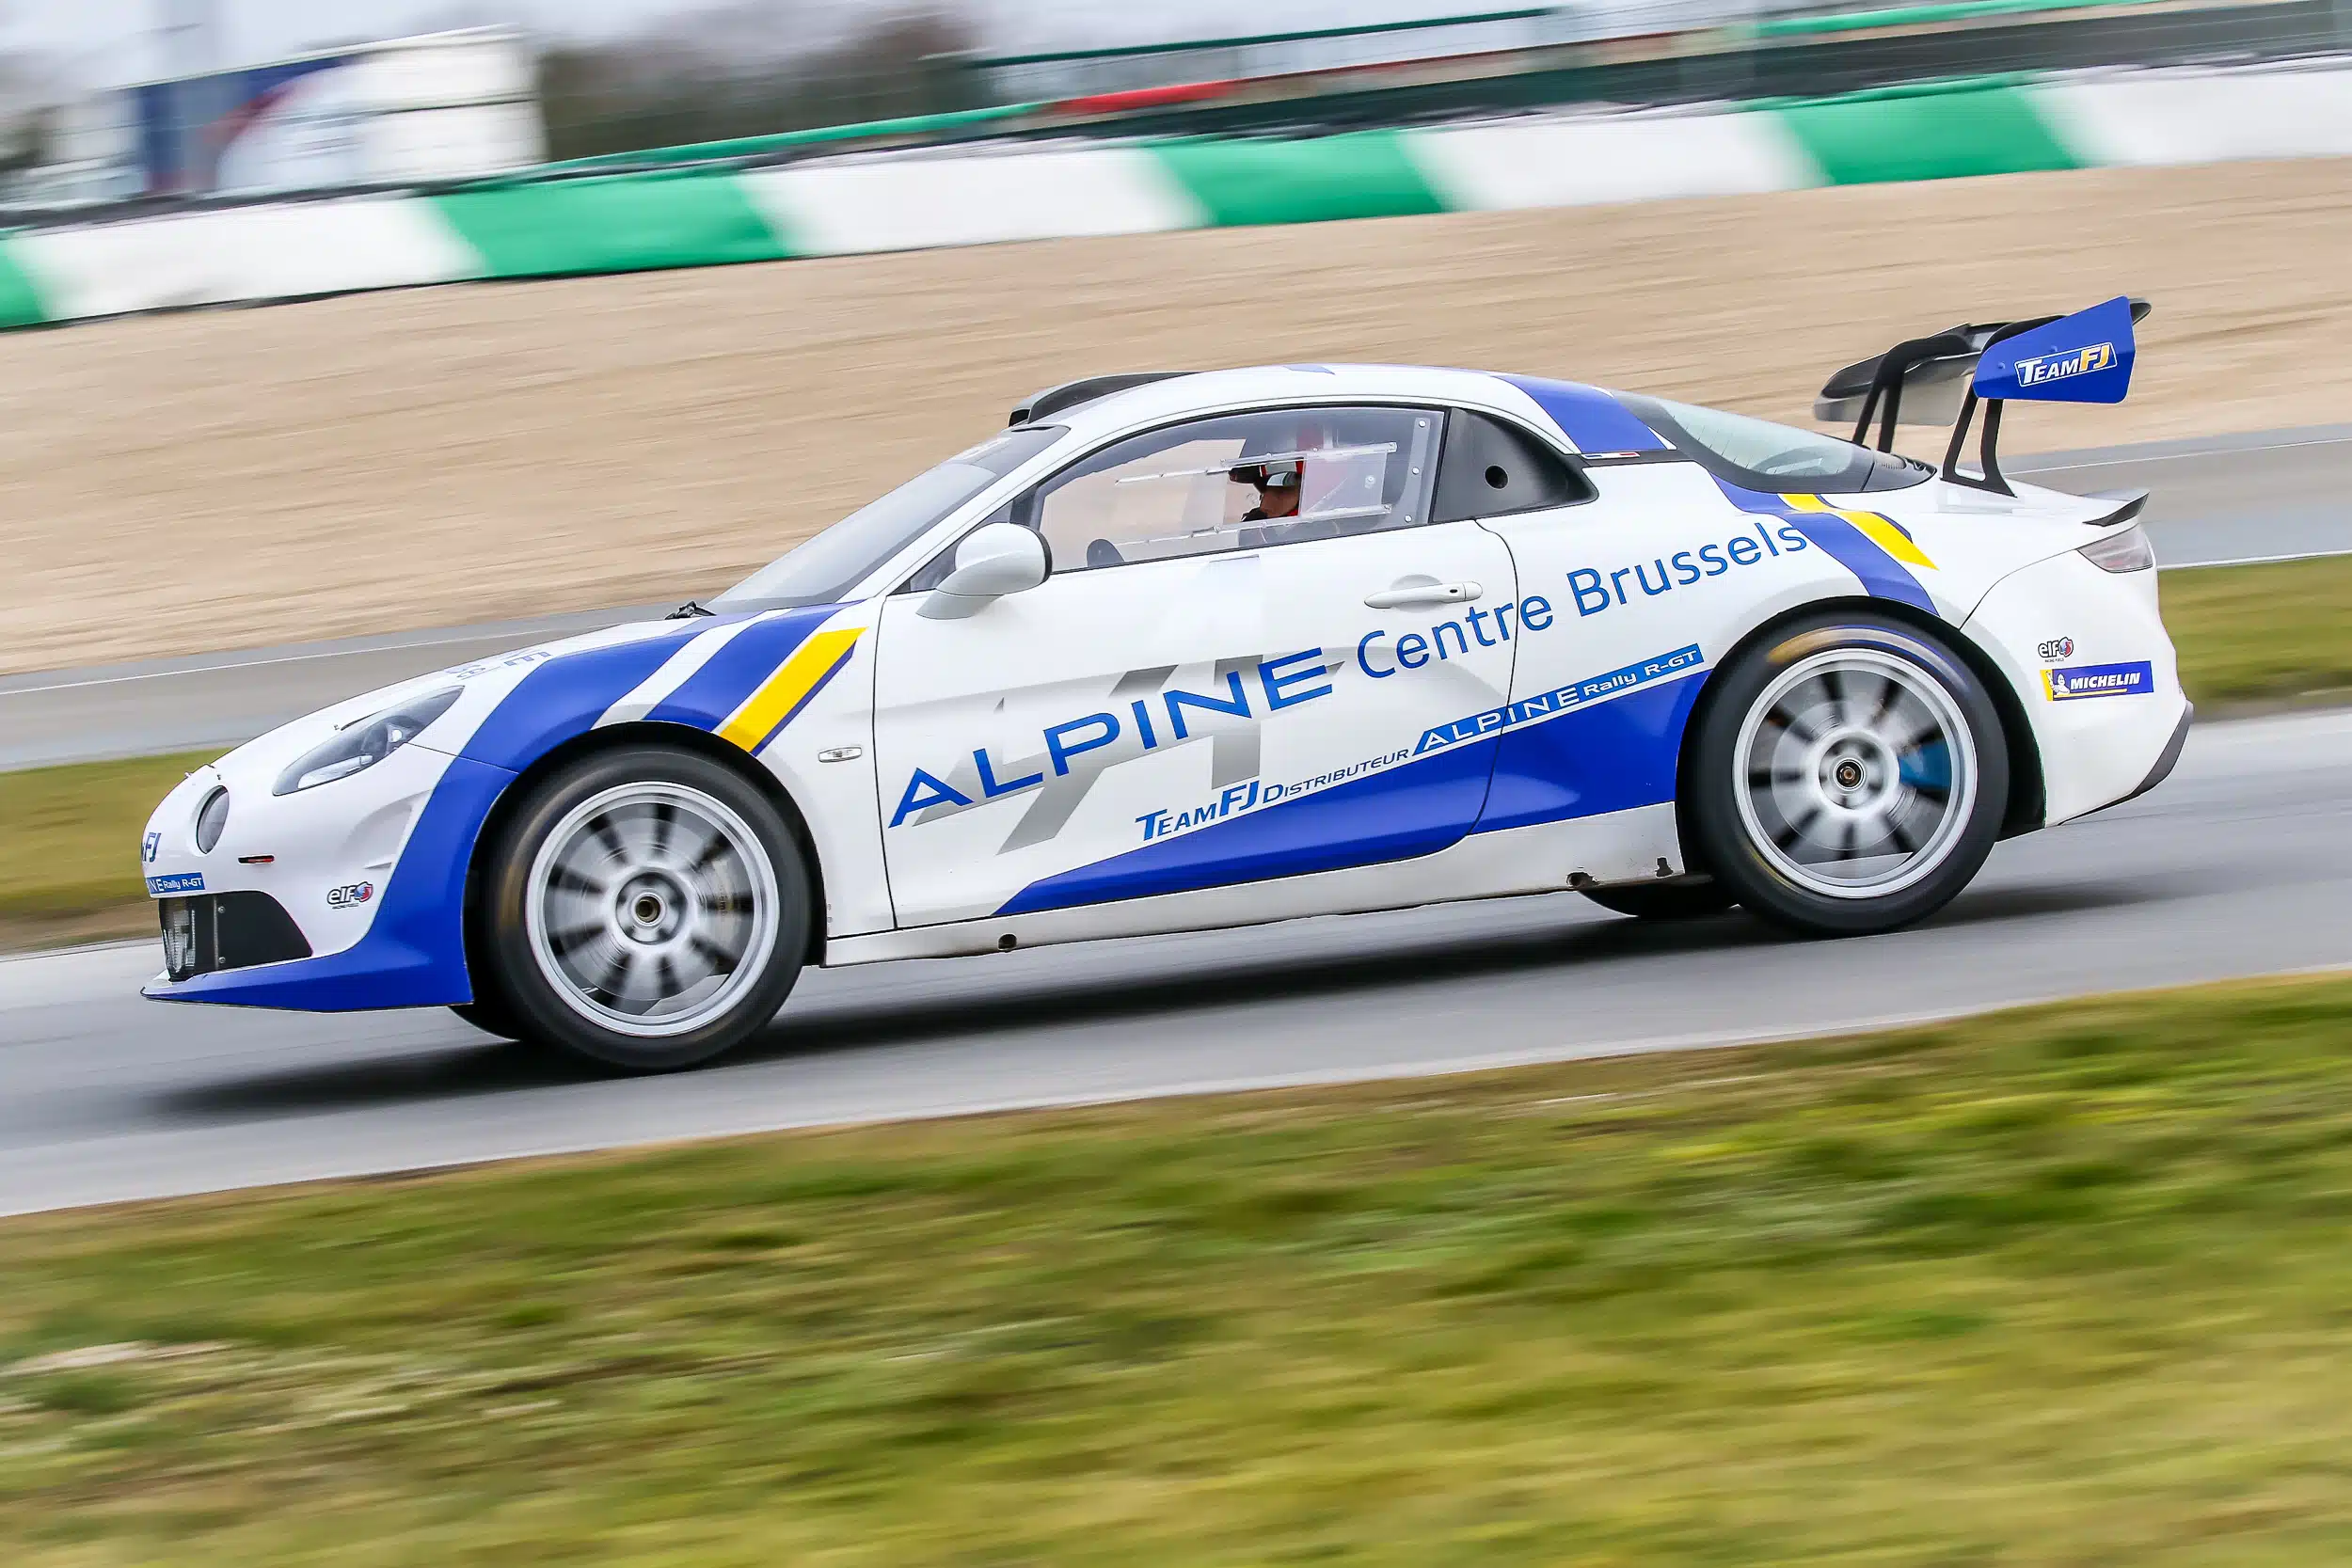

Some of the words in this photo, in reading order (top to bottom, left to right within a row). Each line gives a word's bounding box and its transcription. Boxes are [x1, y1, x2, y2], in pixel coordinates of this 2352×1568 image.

[888, 647, 1332, 828] ALPINE
[1358, 594, 1553, 678] Centre
[1566, 522, 1807, 617] Brussels
[2070, 673, 2140, 690] MICHELIN
[1423, 688, 1580, 751] ALPINE
[1583, 672, 1637, 697] Rally
[1645, 650, 1698, 676] R-GT
[141, 832, 162, 863] FJ
[182, 878, 201, 887] R-GT
